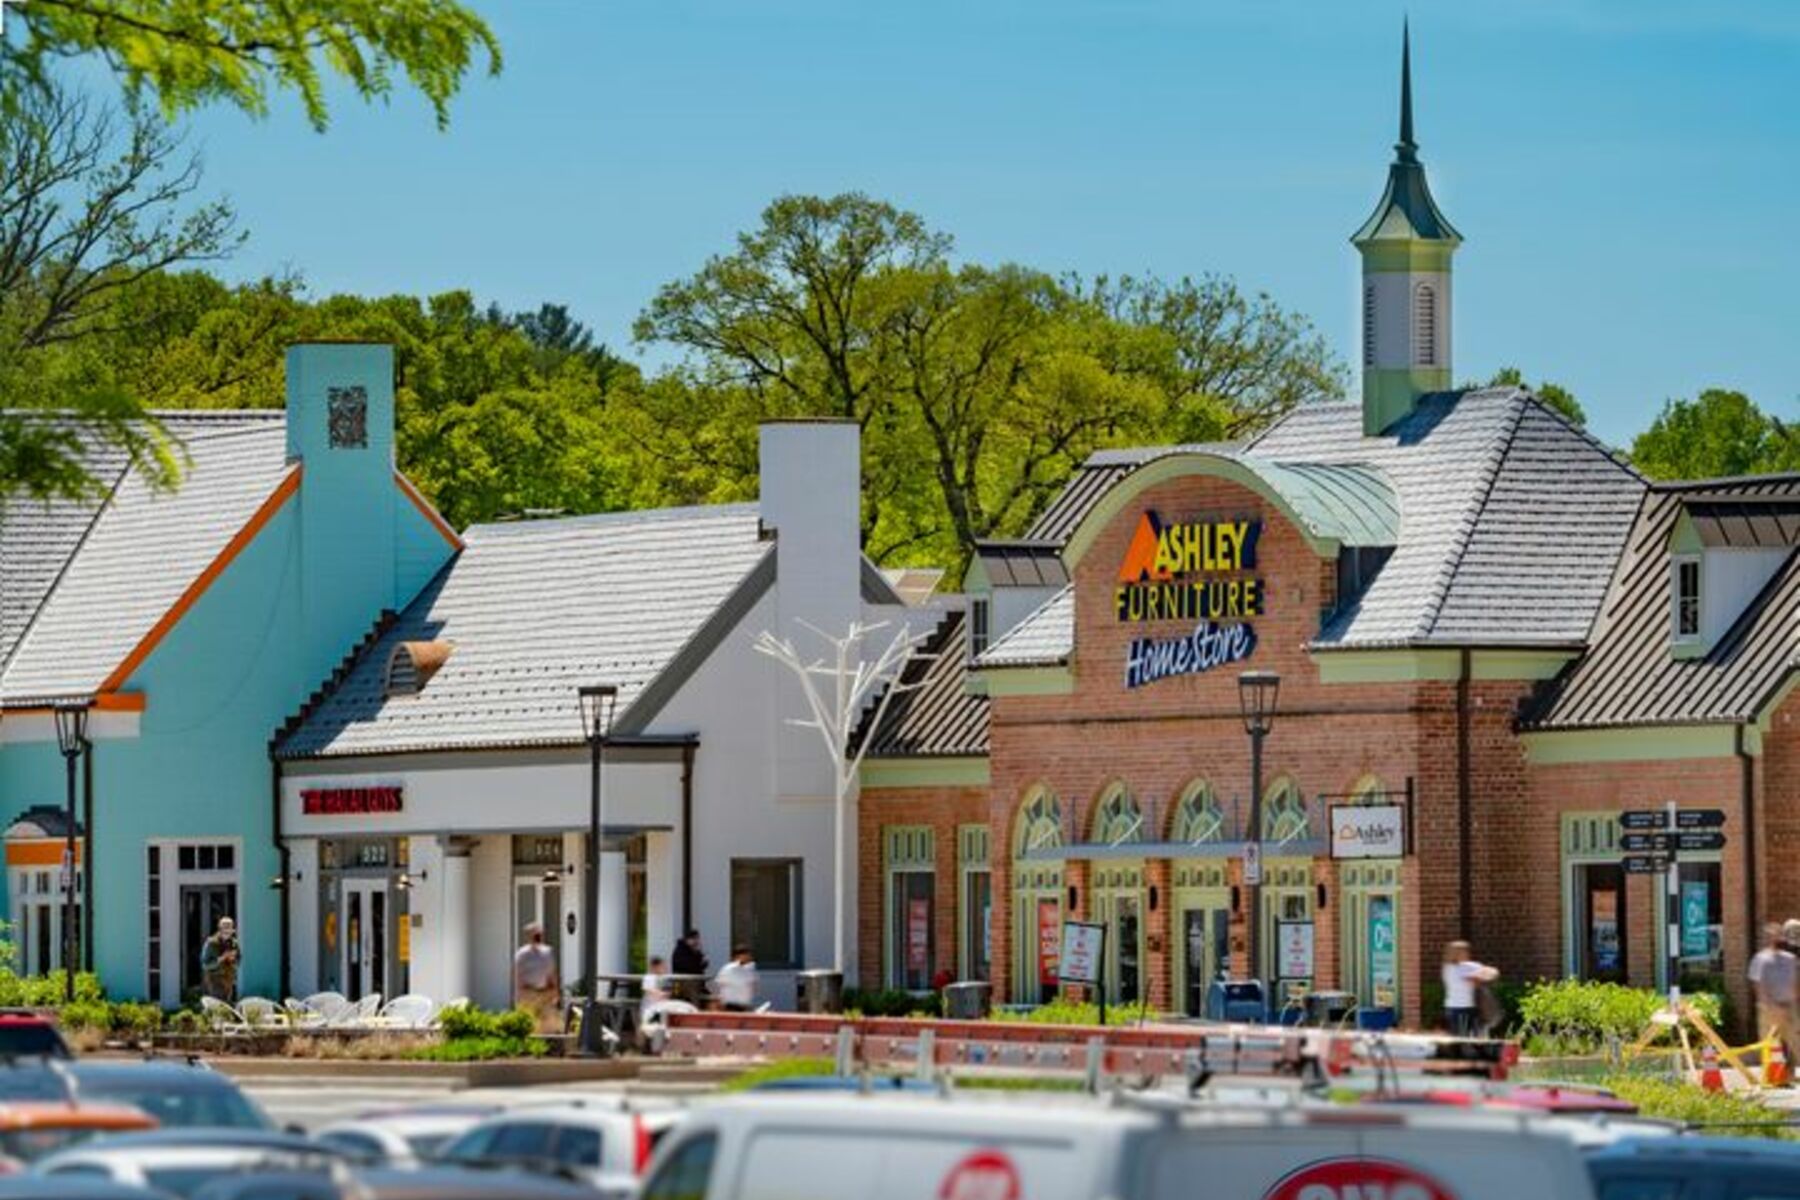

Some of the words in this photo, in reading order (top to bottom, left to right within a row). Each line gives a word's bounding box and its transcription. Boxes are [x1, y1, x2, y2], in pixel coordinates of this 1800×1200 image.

[1154, 521, 1249, 572] ASHLEY
[1115, 580, 1258, 621] FURNITURE
[1356, 823, 1395, 841] Ashley
